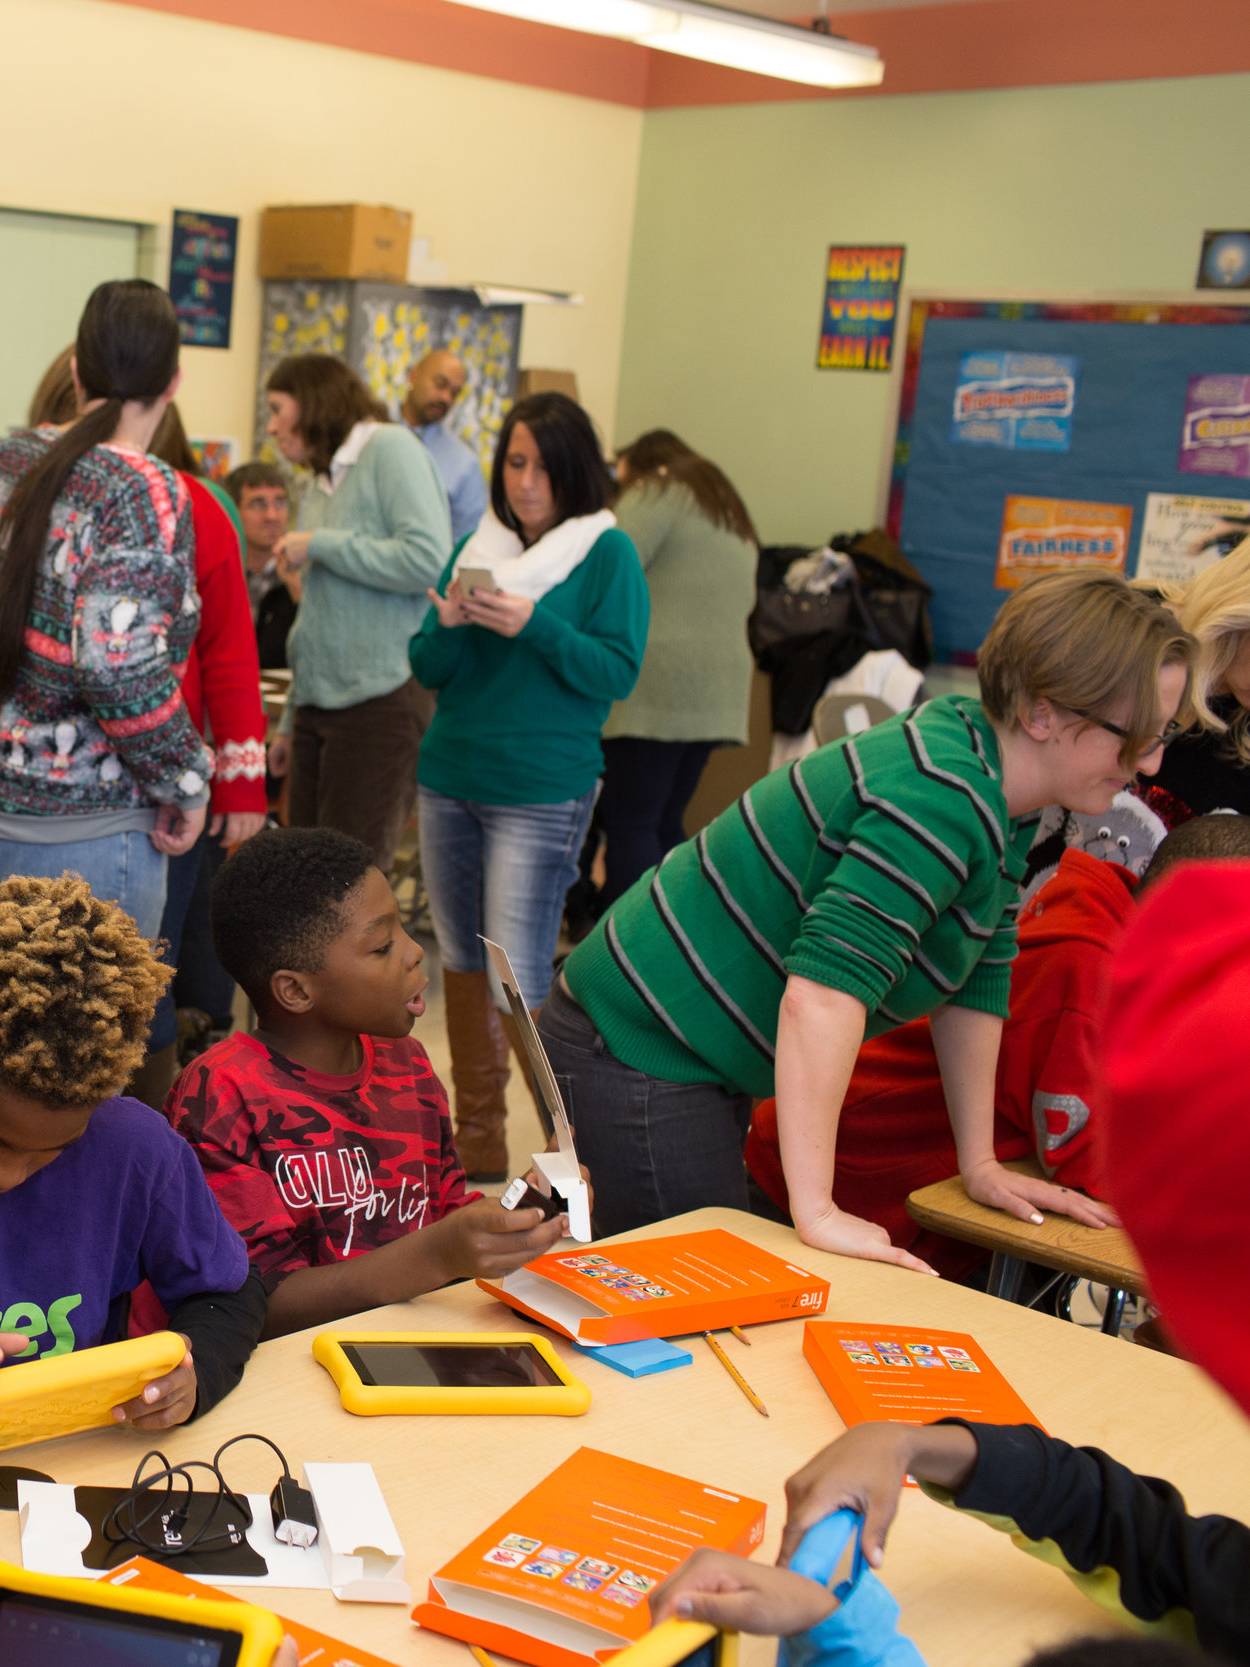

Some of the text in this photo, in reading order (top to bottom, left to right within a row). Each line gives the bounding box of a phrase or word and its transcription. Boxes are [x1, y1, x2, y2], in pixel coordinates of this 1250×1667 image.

[828, 298, 894, 320] YOU
[818, 334, 868, 368] EARN
[1010, 537, 1115, 557] FAIRNESS
[790, 1295, 799, 1308] 7
[799, 1291, 823, 1310] fire
